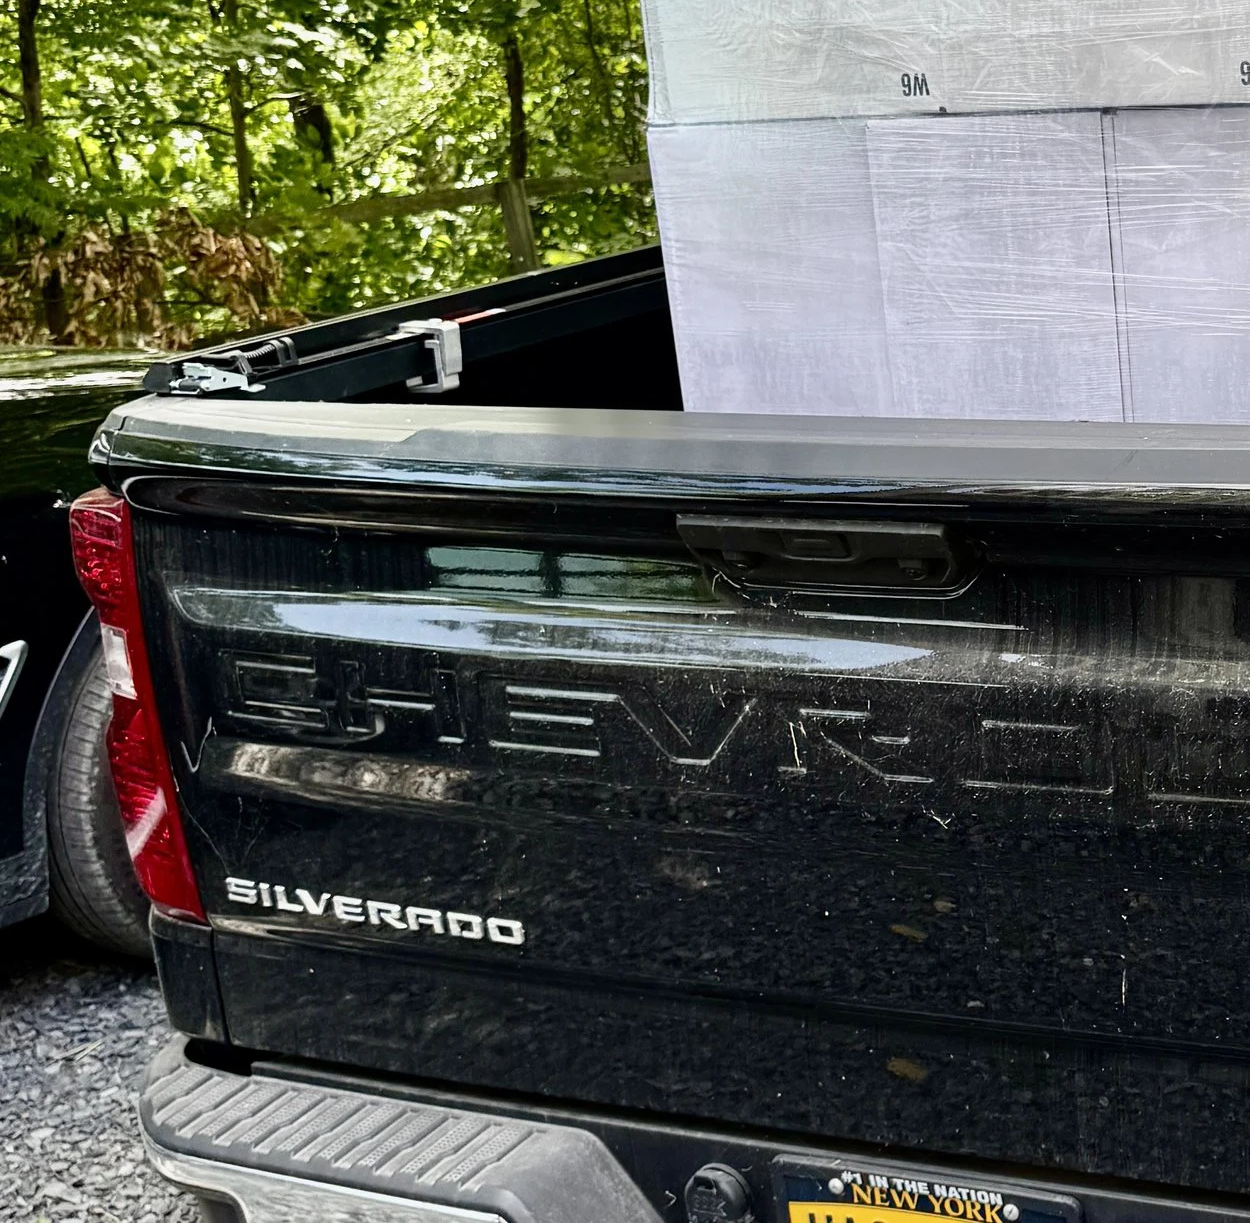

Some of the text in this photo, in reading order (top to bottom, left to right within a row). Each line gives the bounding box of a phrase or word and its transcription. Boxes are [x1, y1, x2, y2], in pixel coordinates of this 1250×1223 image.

[900, 73, 930, 97] W6
[226, 876, 525, 946] SILVERADO
[851, 1183, 1004, 1223] NEW YORK
[869, 1174, 889, 1189] IN
[893, 1178, 930, 1195] THE
[934, 1184, 1003, 1206] NATION
